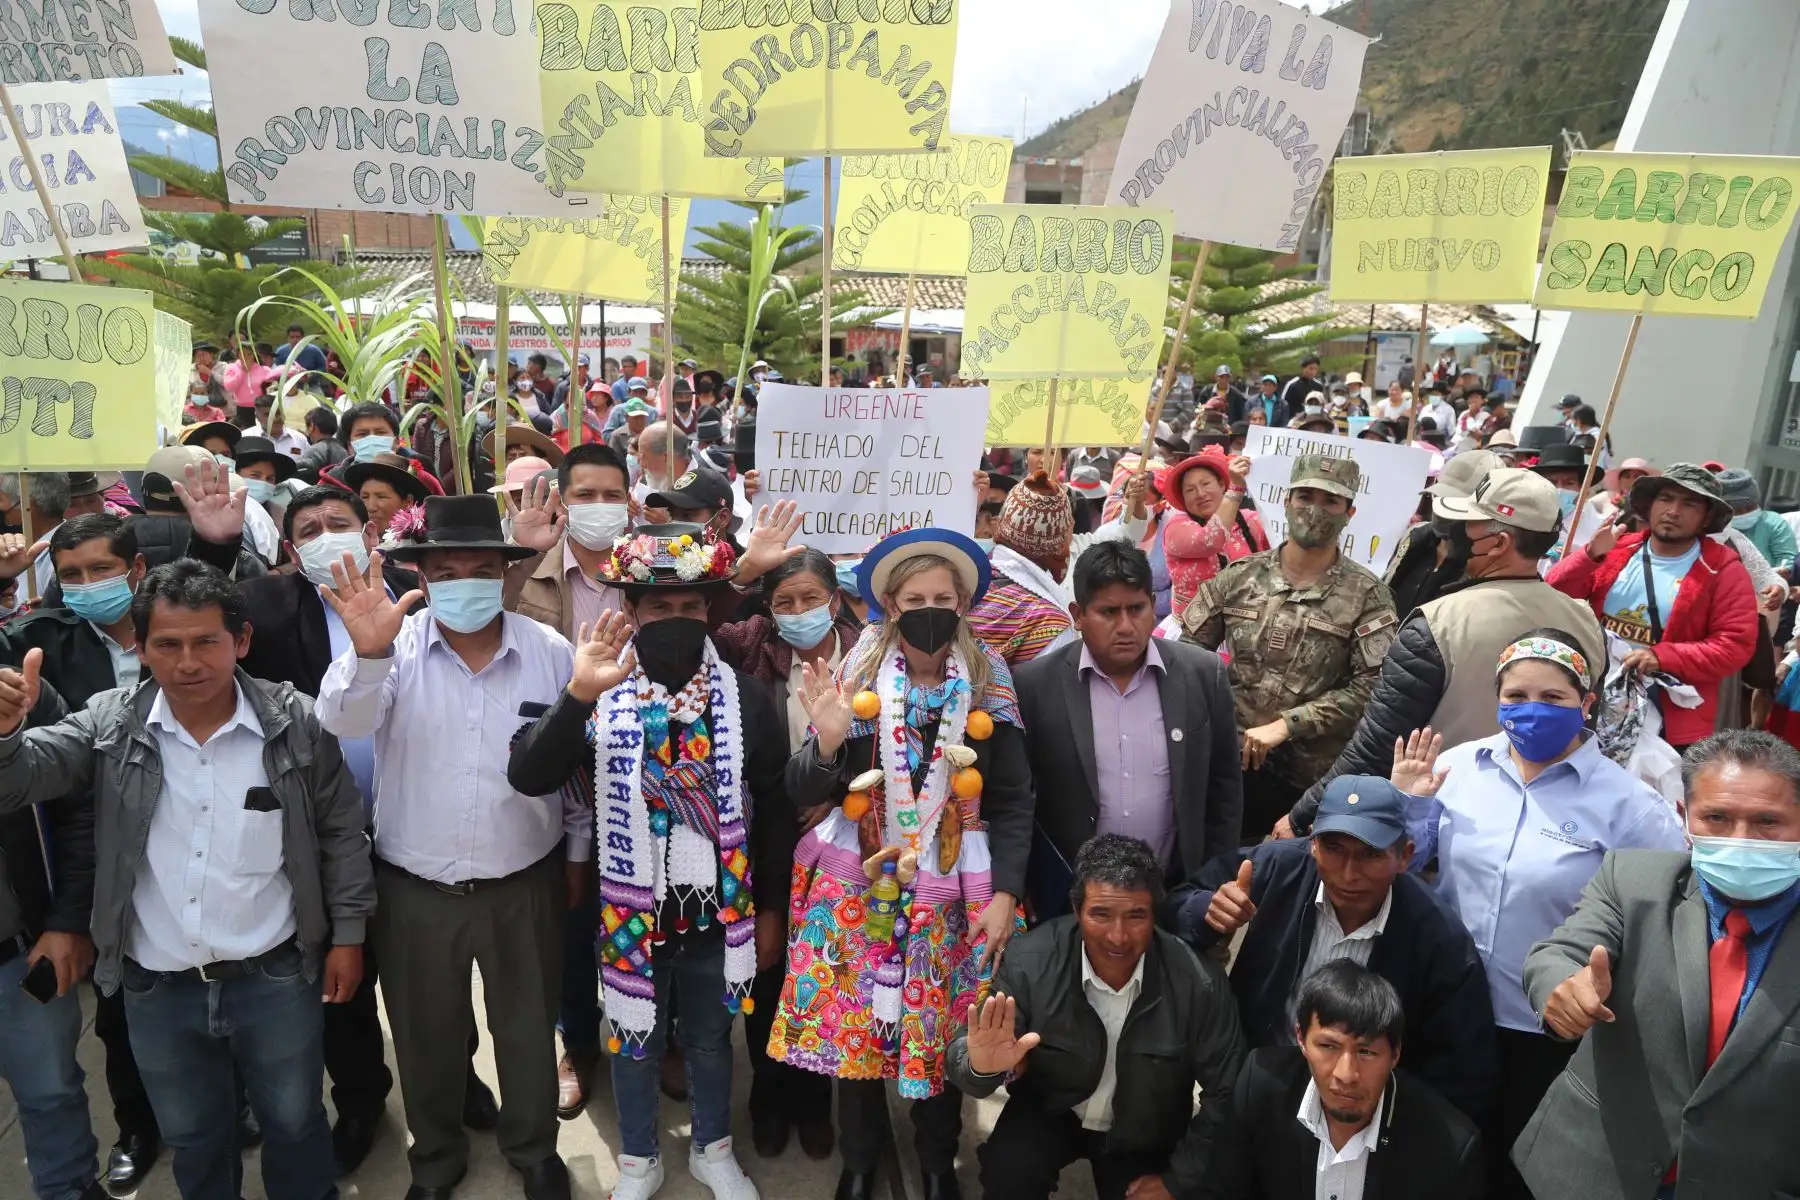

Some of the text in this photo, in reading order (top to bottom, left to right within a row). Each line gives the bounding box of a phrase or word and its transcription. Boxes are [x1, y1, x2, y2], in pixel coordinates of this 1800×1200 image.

[537, 3, 700, 73] BARR
[1188, 0, 1333, 90] VIVA LA
[364, 37, 459, 105] LA
[704, 23, 947, 157] CEDROPAMPA
[0, 149, 97, 194] CIA
[226, 106, 549, 201] PROVINCIALIZ
[1120, 86, 1324, 250] PROVINCIALIZACION
[354, 161, 475, 211] CION
[1334, 166, 1540, 221] BARRIO
[1555, 165, 1793, 232] BARRIO
[968, 215, 1164, 275] BARRIO
[1357, 238, 1500, 273] NUEVO
[1547, 239, 1755, 301] SANCO
[508, 326, 547, 336] ARTIDO
[509, 339, 548, 348] UESTROS
[961, 273, 1154, 378] PACCHAPATA
[824, 393, 928, 420] URGENTE
[772, 430, 944, 460] TECHADO DEL
[767, 468, 953, 496] CENTRO DE SALUD
[1601, 615, 1657, 645] CRISTA
